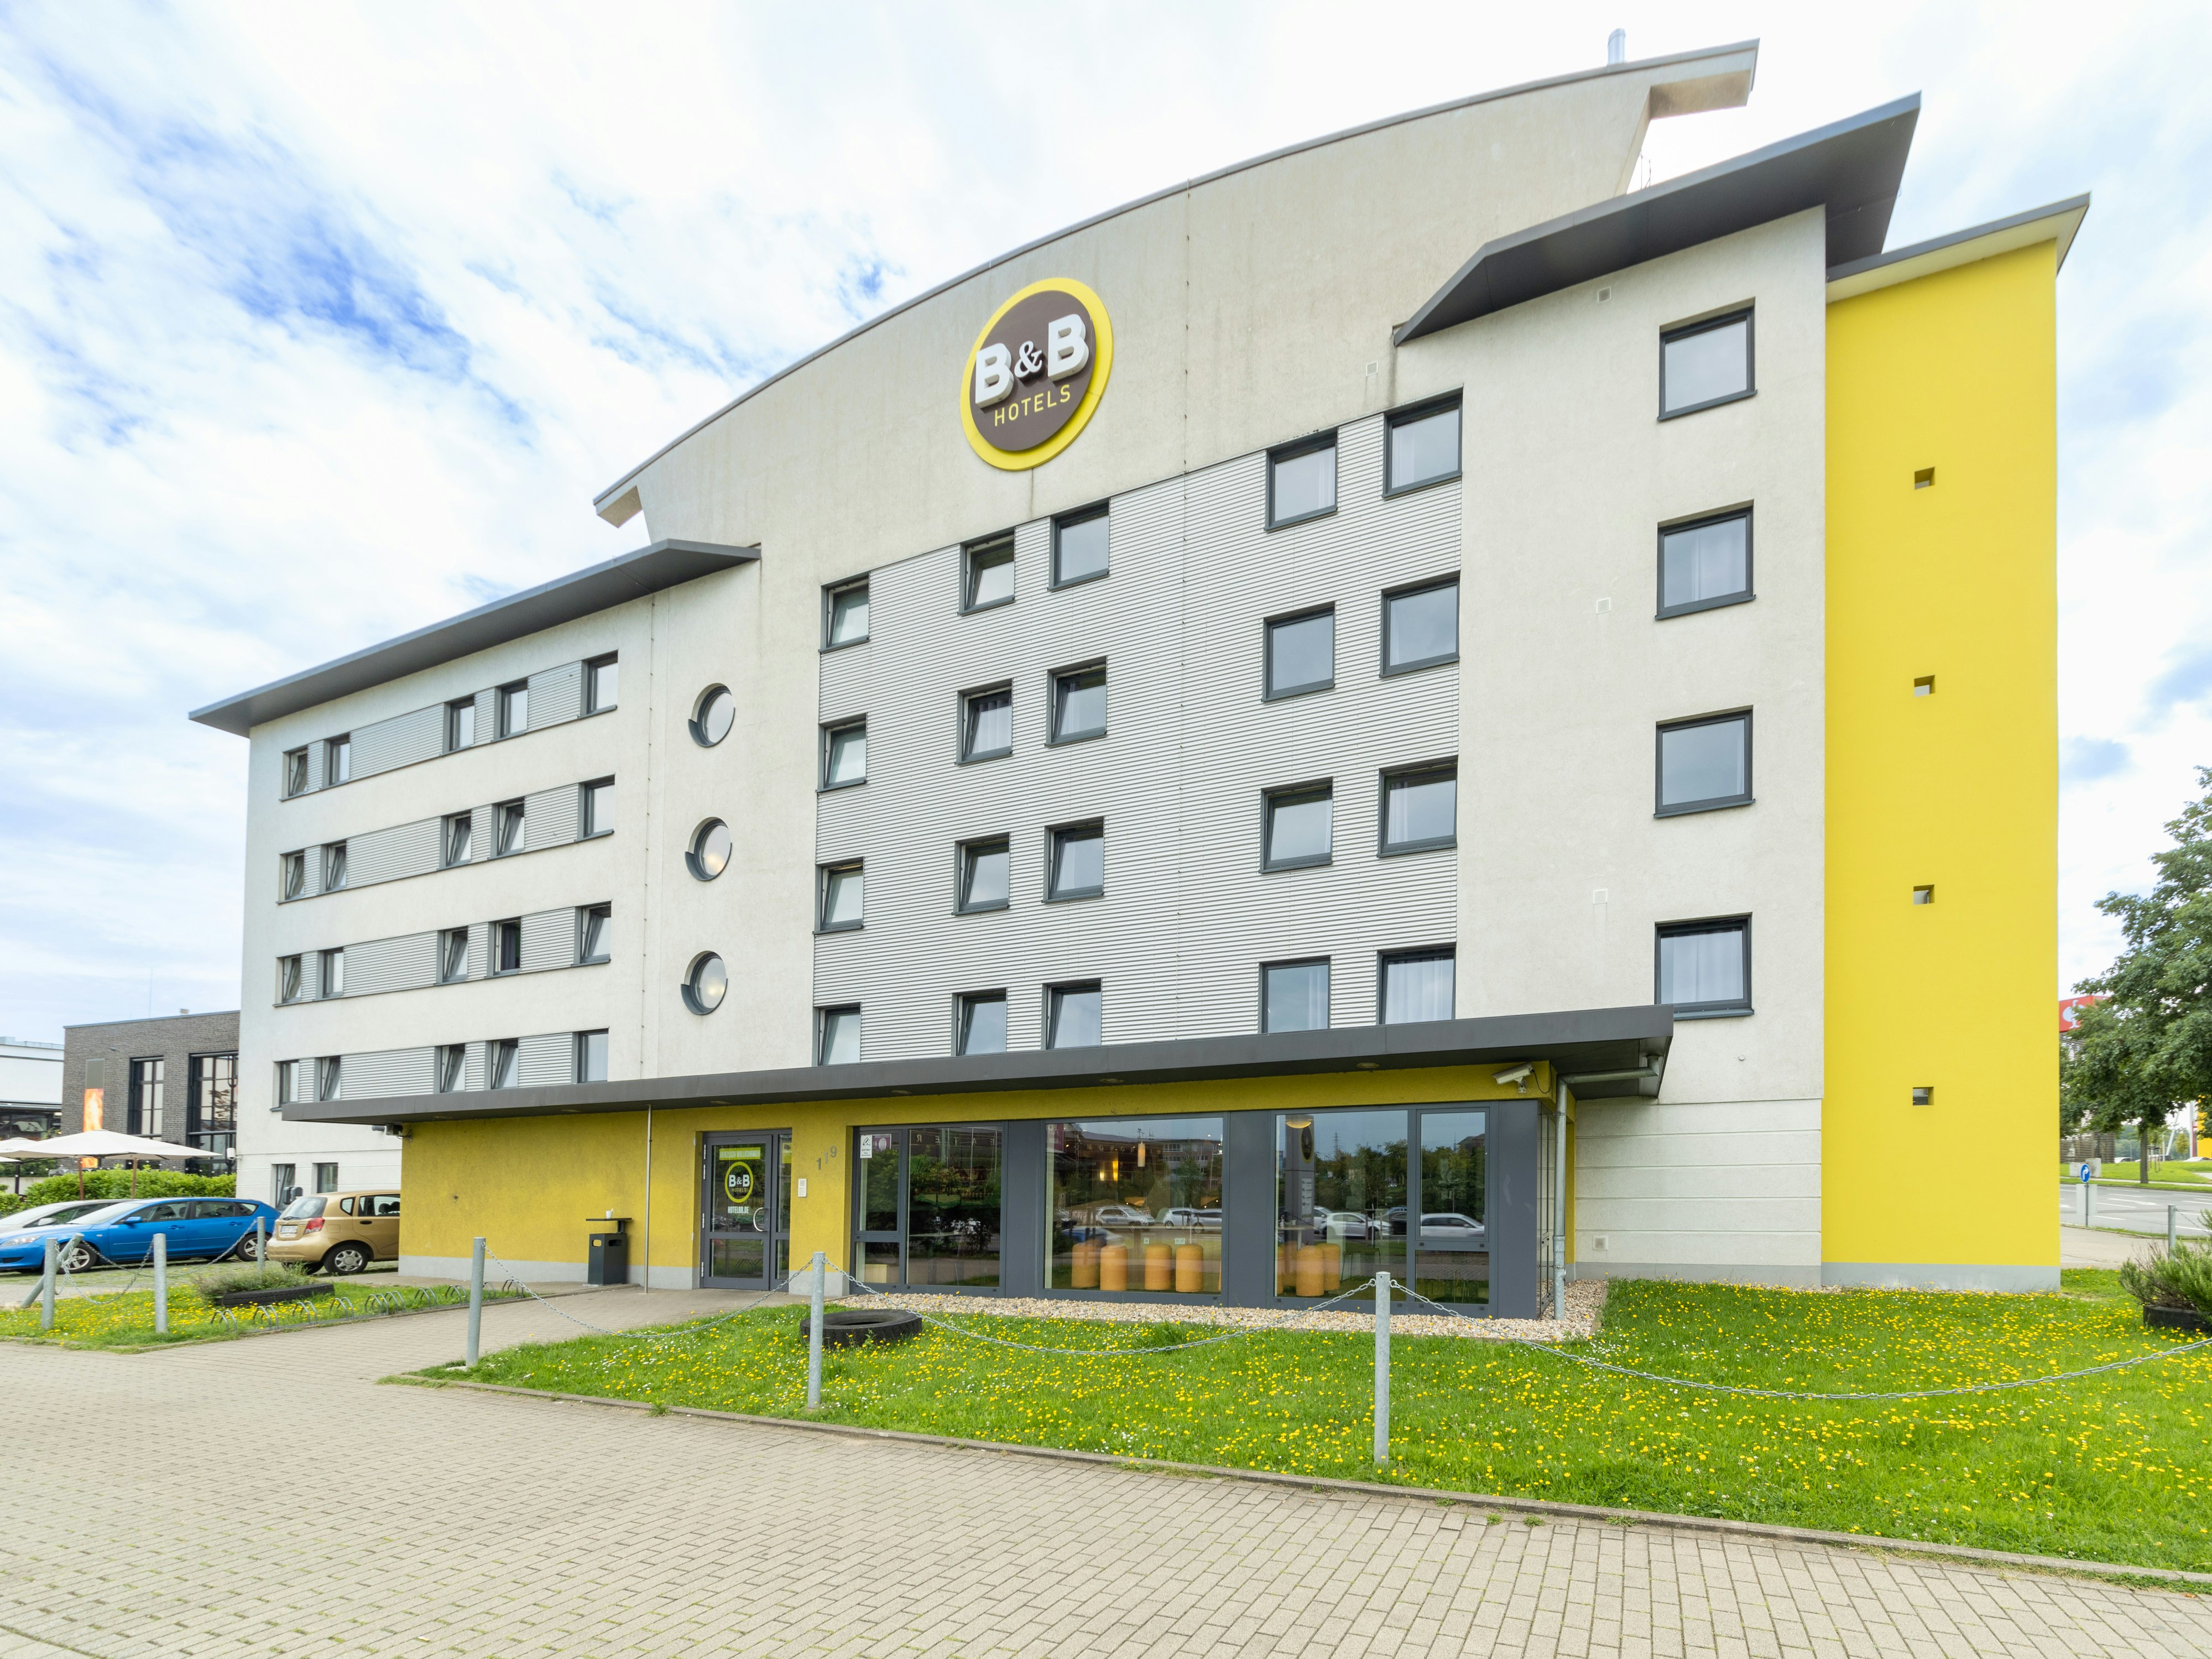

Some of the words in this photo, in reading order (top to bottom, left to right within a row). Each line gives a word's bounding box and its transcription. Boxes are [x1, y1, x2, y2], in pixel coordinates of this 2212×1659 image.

[975, 314, 1089, 409] B&B
[994, 384, 1071, 427] HOTELS
[816, 1145, 837, 1170] 119
[729, 1175, 750, 1187] B&B
